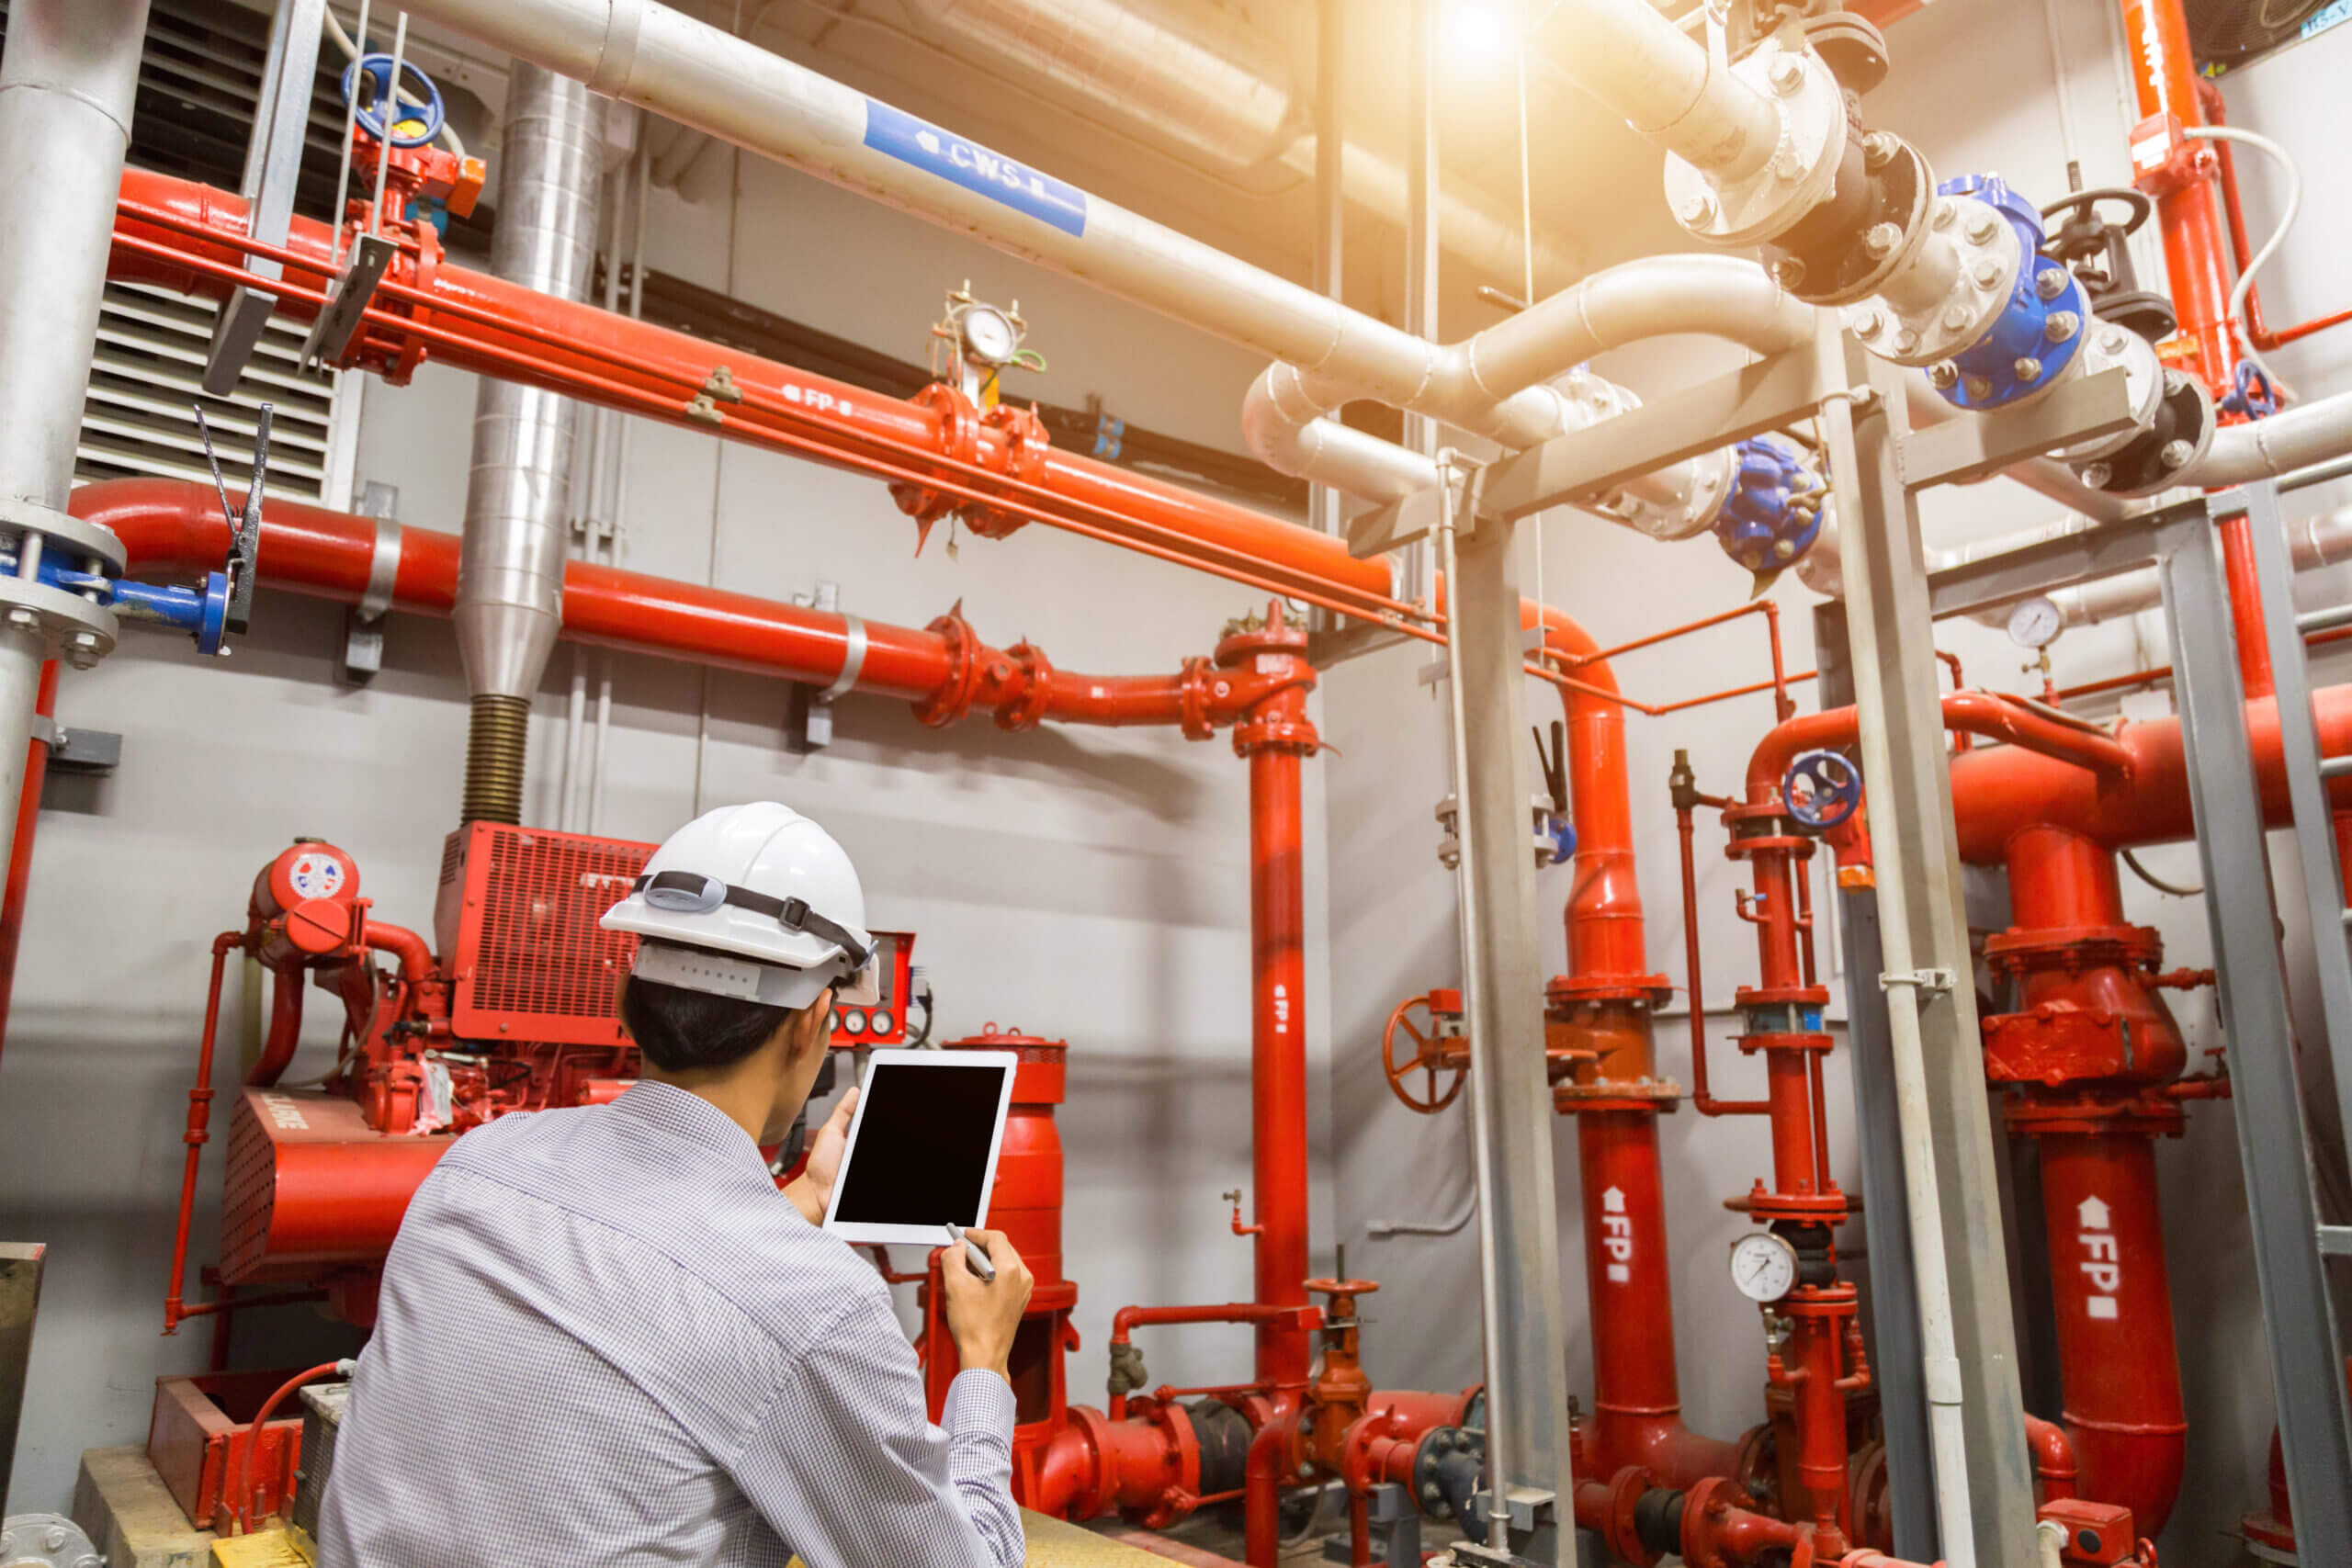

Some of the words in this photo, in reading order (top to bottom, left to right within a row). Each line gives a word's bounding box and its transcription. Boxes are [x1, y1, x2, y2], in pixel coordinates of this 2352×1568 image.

[950, 143, 1021, 188] CWS
[805, 388, 833, 411] FP
[1274, 1000, 1288, 1021] FP
[1602, 1216, 1631, 1261] FP
[2078, 1235, 2119, 1292] FP
